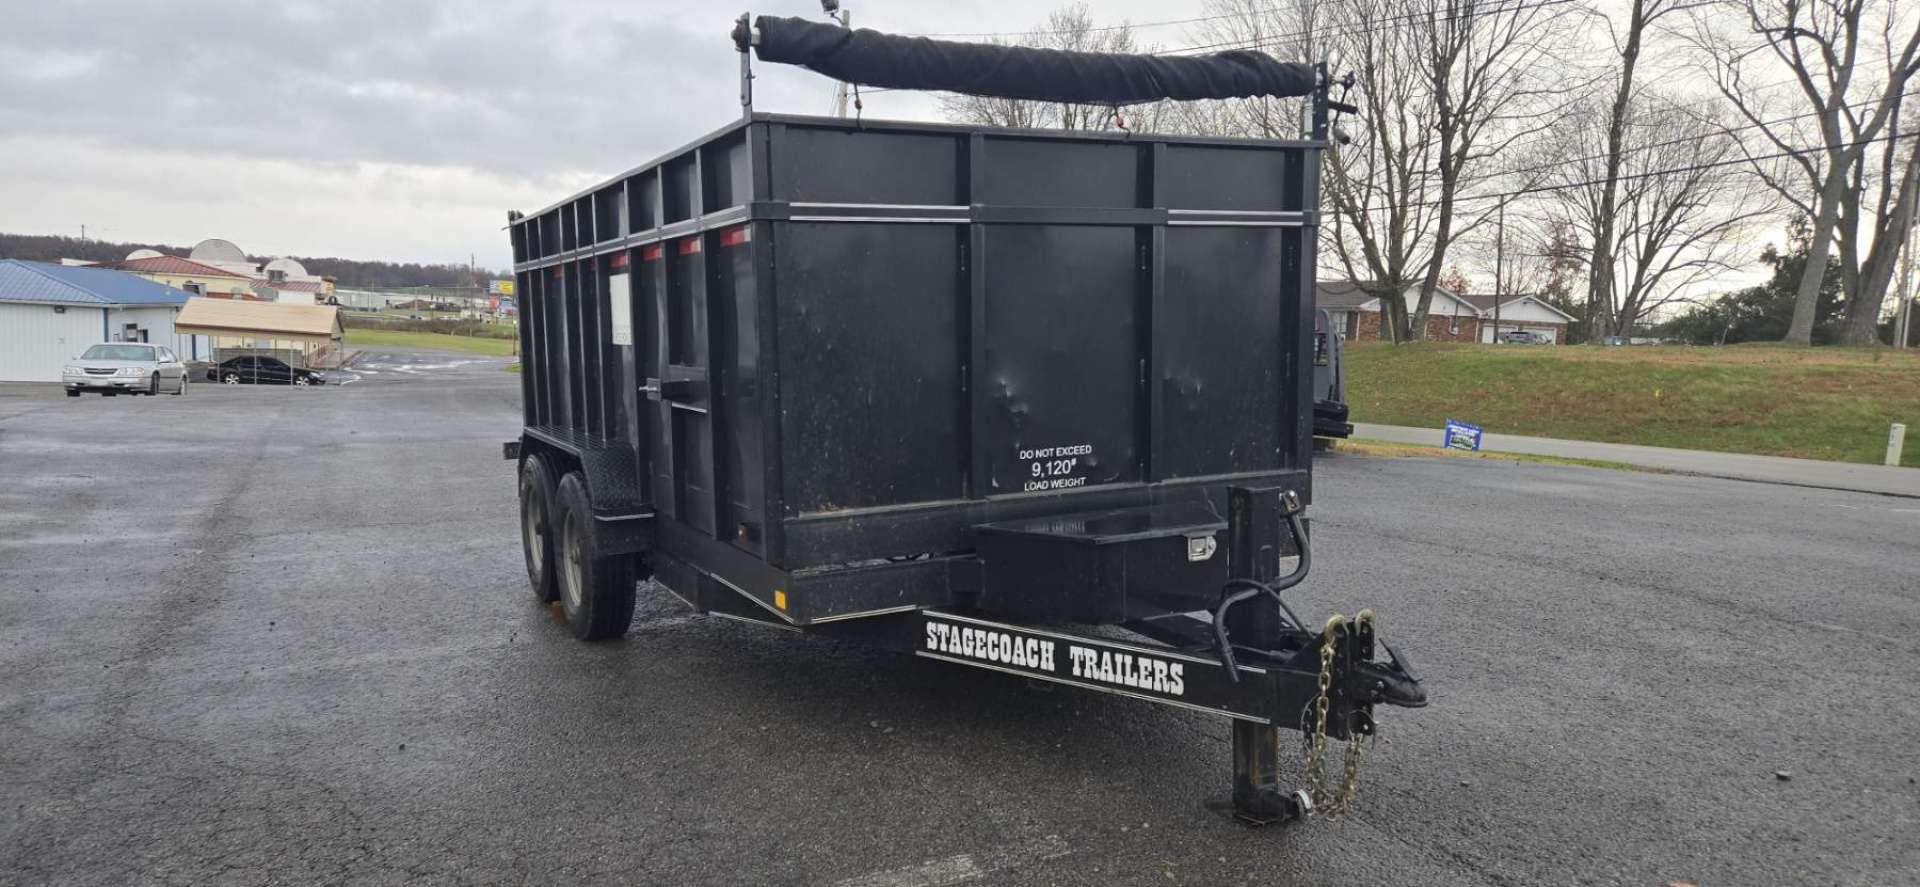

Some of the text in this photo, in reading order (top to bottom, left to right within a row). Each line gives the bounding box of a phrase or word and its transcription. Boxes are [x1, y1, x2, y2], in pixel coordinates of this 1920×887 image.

[1020, 445, 1091, 460] DO NOT EXCEED
[1025, 477, 1086, 491] LOAD WEIGHT
[926, 623, 1184, 695] STAGECOACH TRAILERS
